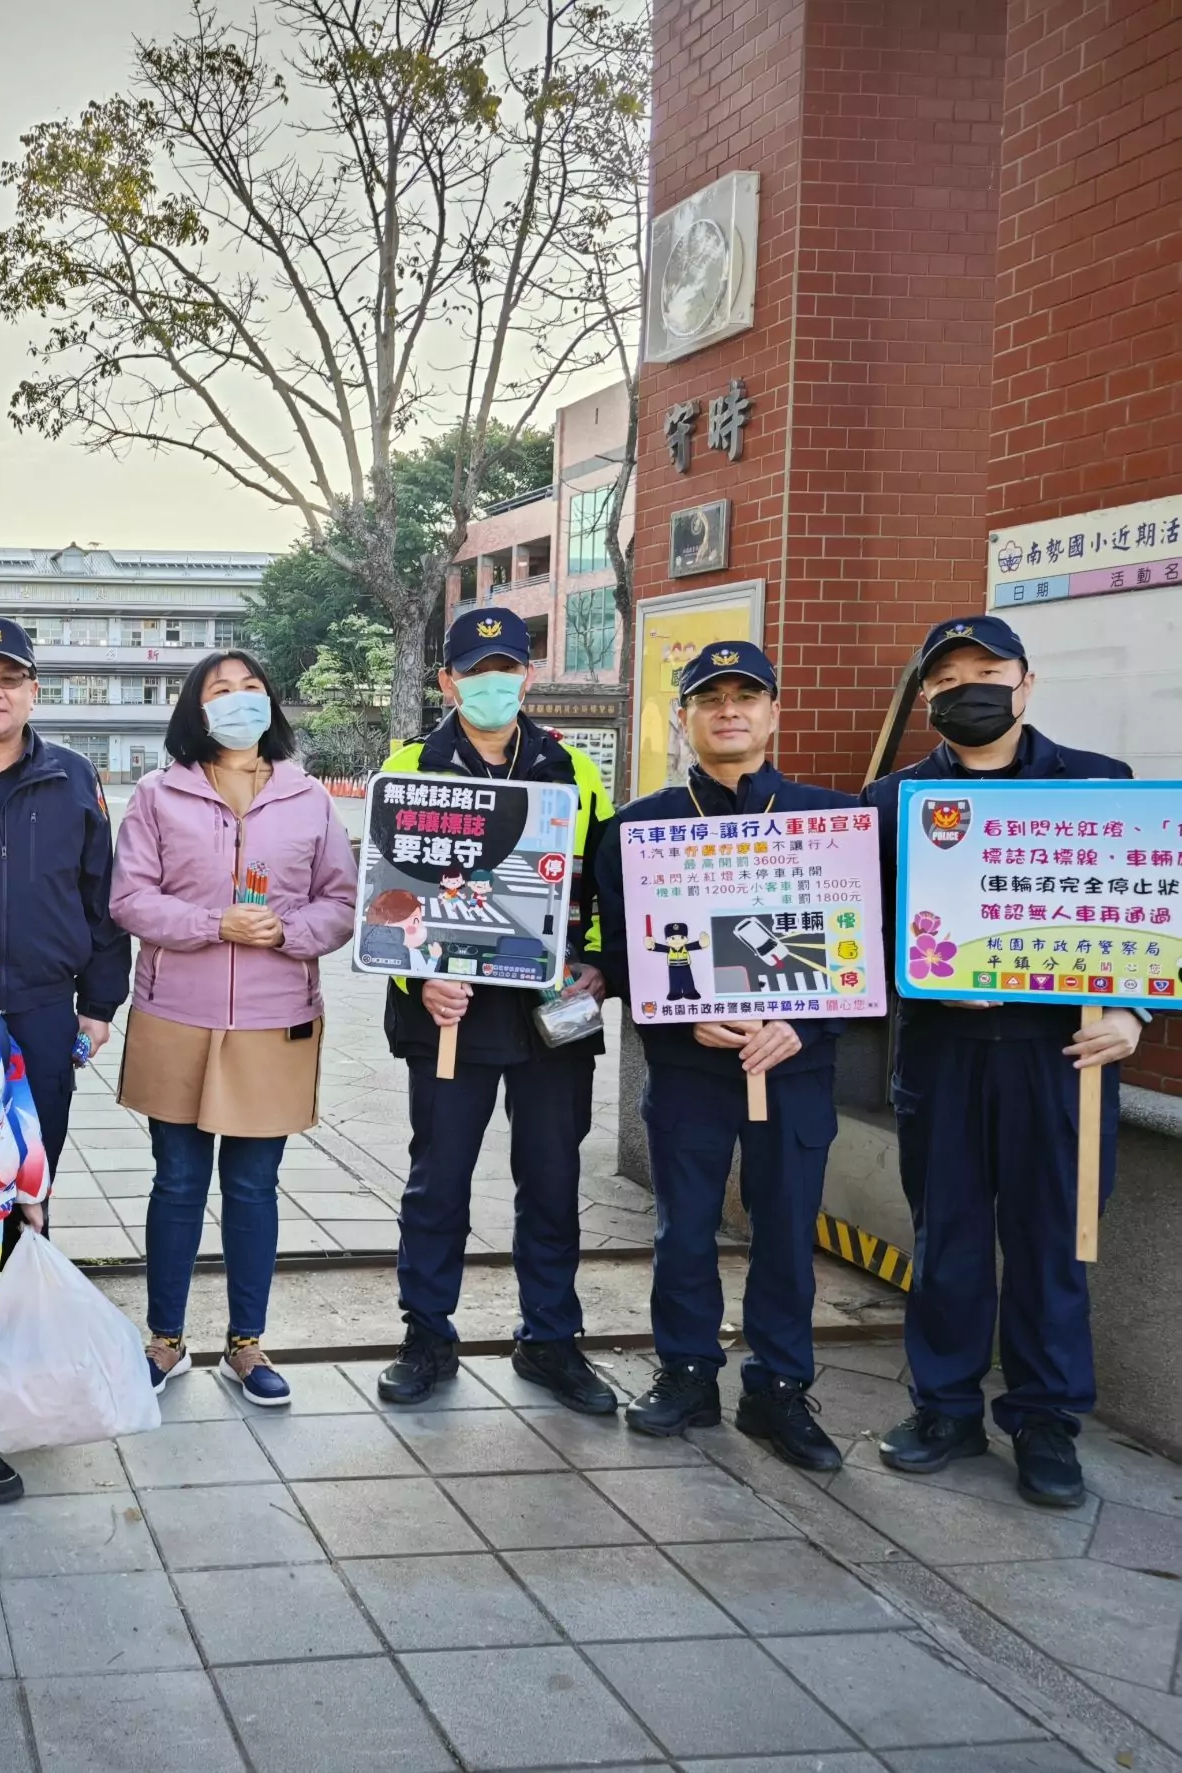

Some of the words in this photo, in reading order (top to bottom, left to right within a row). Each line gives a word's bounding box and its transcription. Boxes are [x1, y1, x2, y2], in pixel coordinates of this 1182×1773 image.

[1026, 517, 1181, 566] 南勢國小近期活
[1110, 563, 1179, 589] 活動名
[1013, 581, 1049, 601] 日期
[384, 782, 496, 811] 無號誌路口
[396, 809, 486, 836] 停讓標誌
[984, 820, 1182, 838] 看到閃光紅燈、「
[932, 831, 959, 841] POLICE
[393, 834, 483, 868] 要遵守
[982, 847, 1182, 867] 標誌及標線，車輛
[544, 859, 562, 877] 停
[775, 911, 824, 932] 車輛
[837, 912, 856, 929] 慢
[980, 903, 1171, 924] 確認無人車再通過
[987, 937, 1161, 956] 桃園市政府警察局
[840, 971, 859, 987] 停
